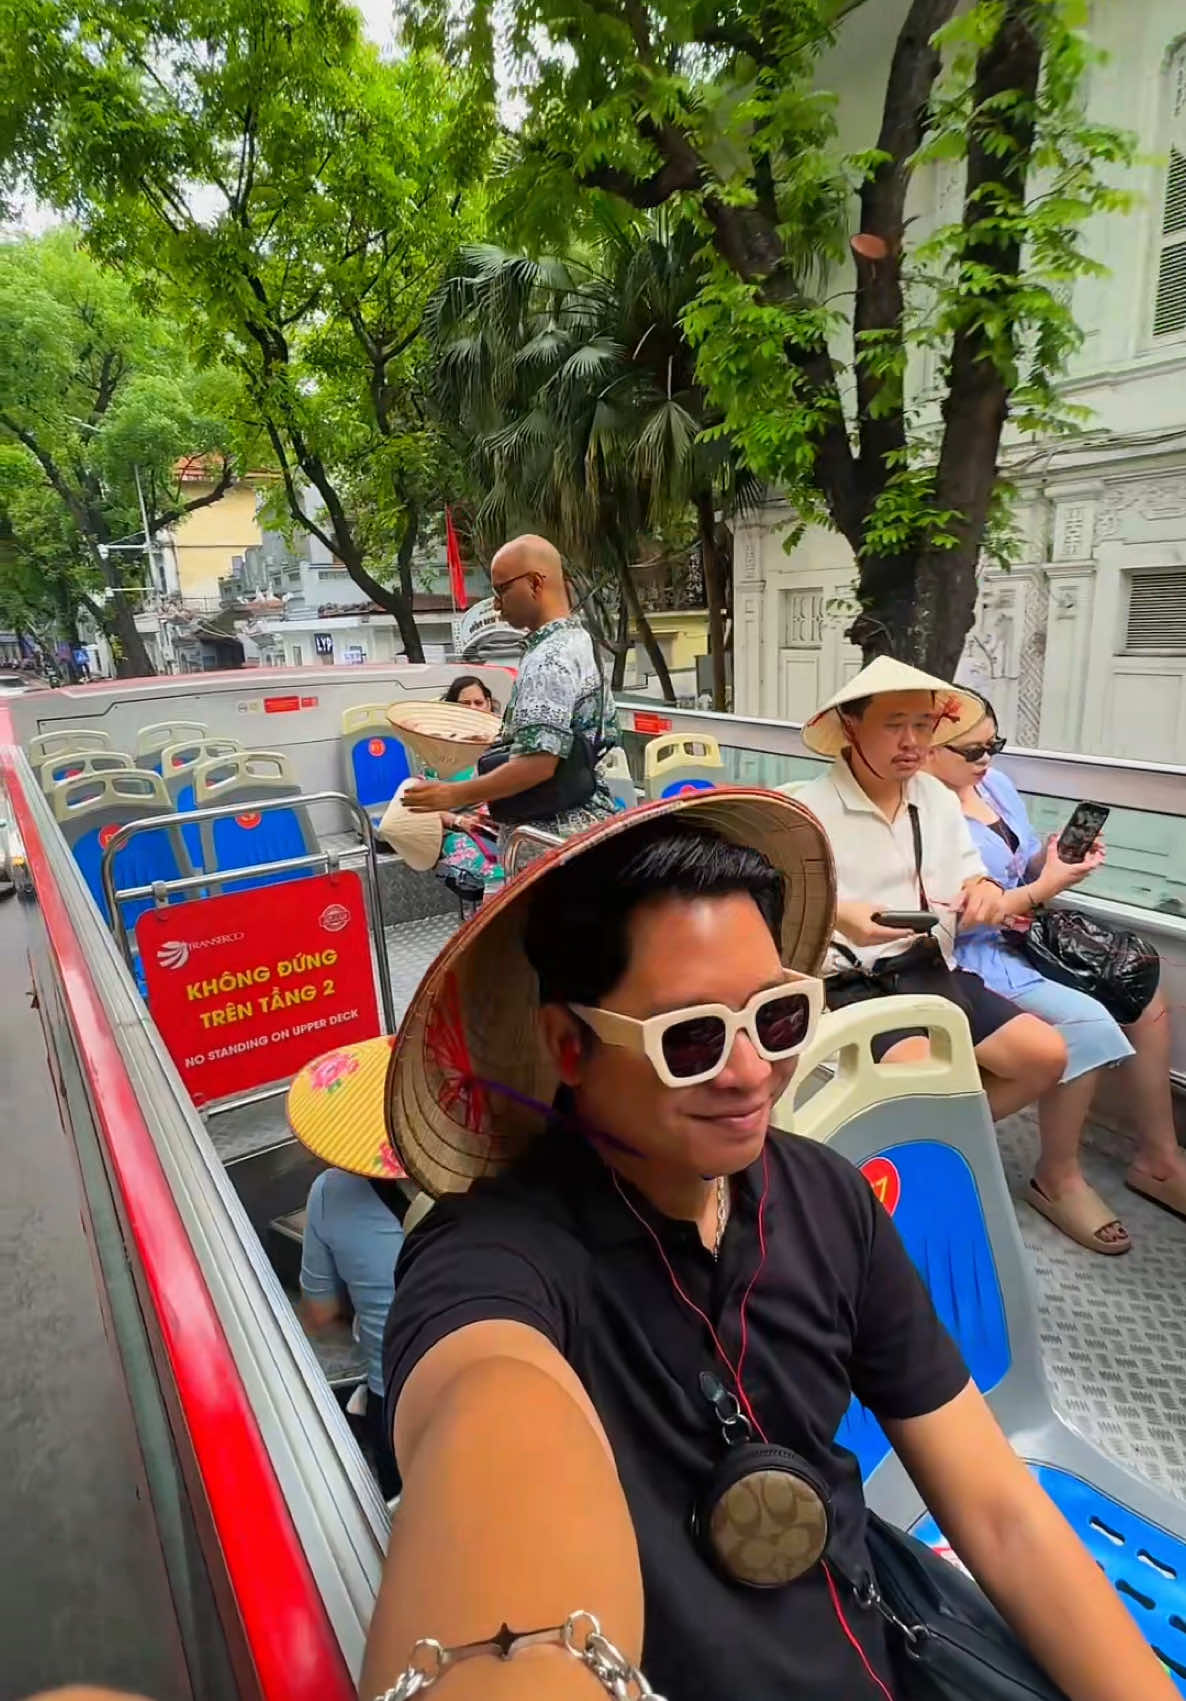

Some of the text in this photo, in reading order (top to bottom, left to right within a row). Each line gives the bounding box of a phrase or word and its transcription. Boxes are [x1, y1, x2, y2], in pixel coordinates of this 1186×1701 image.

[186, 948, 338, 1001] KHÔNG ĐỨNG
[200, 979, 336, 1029] TRÊN TẦNG 2
[185, 1009, 359, 1068] NO STANDING ON UPPER DECK
